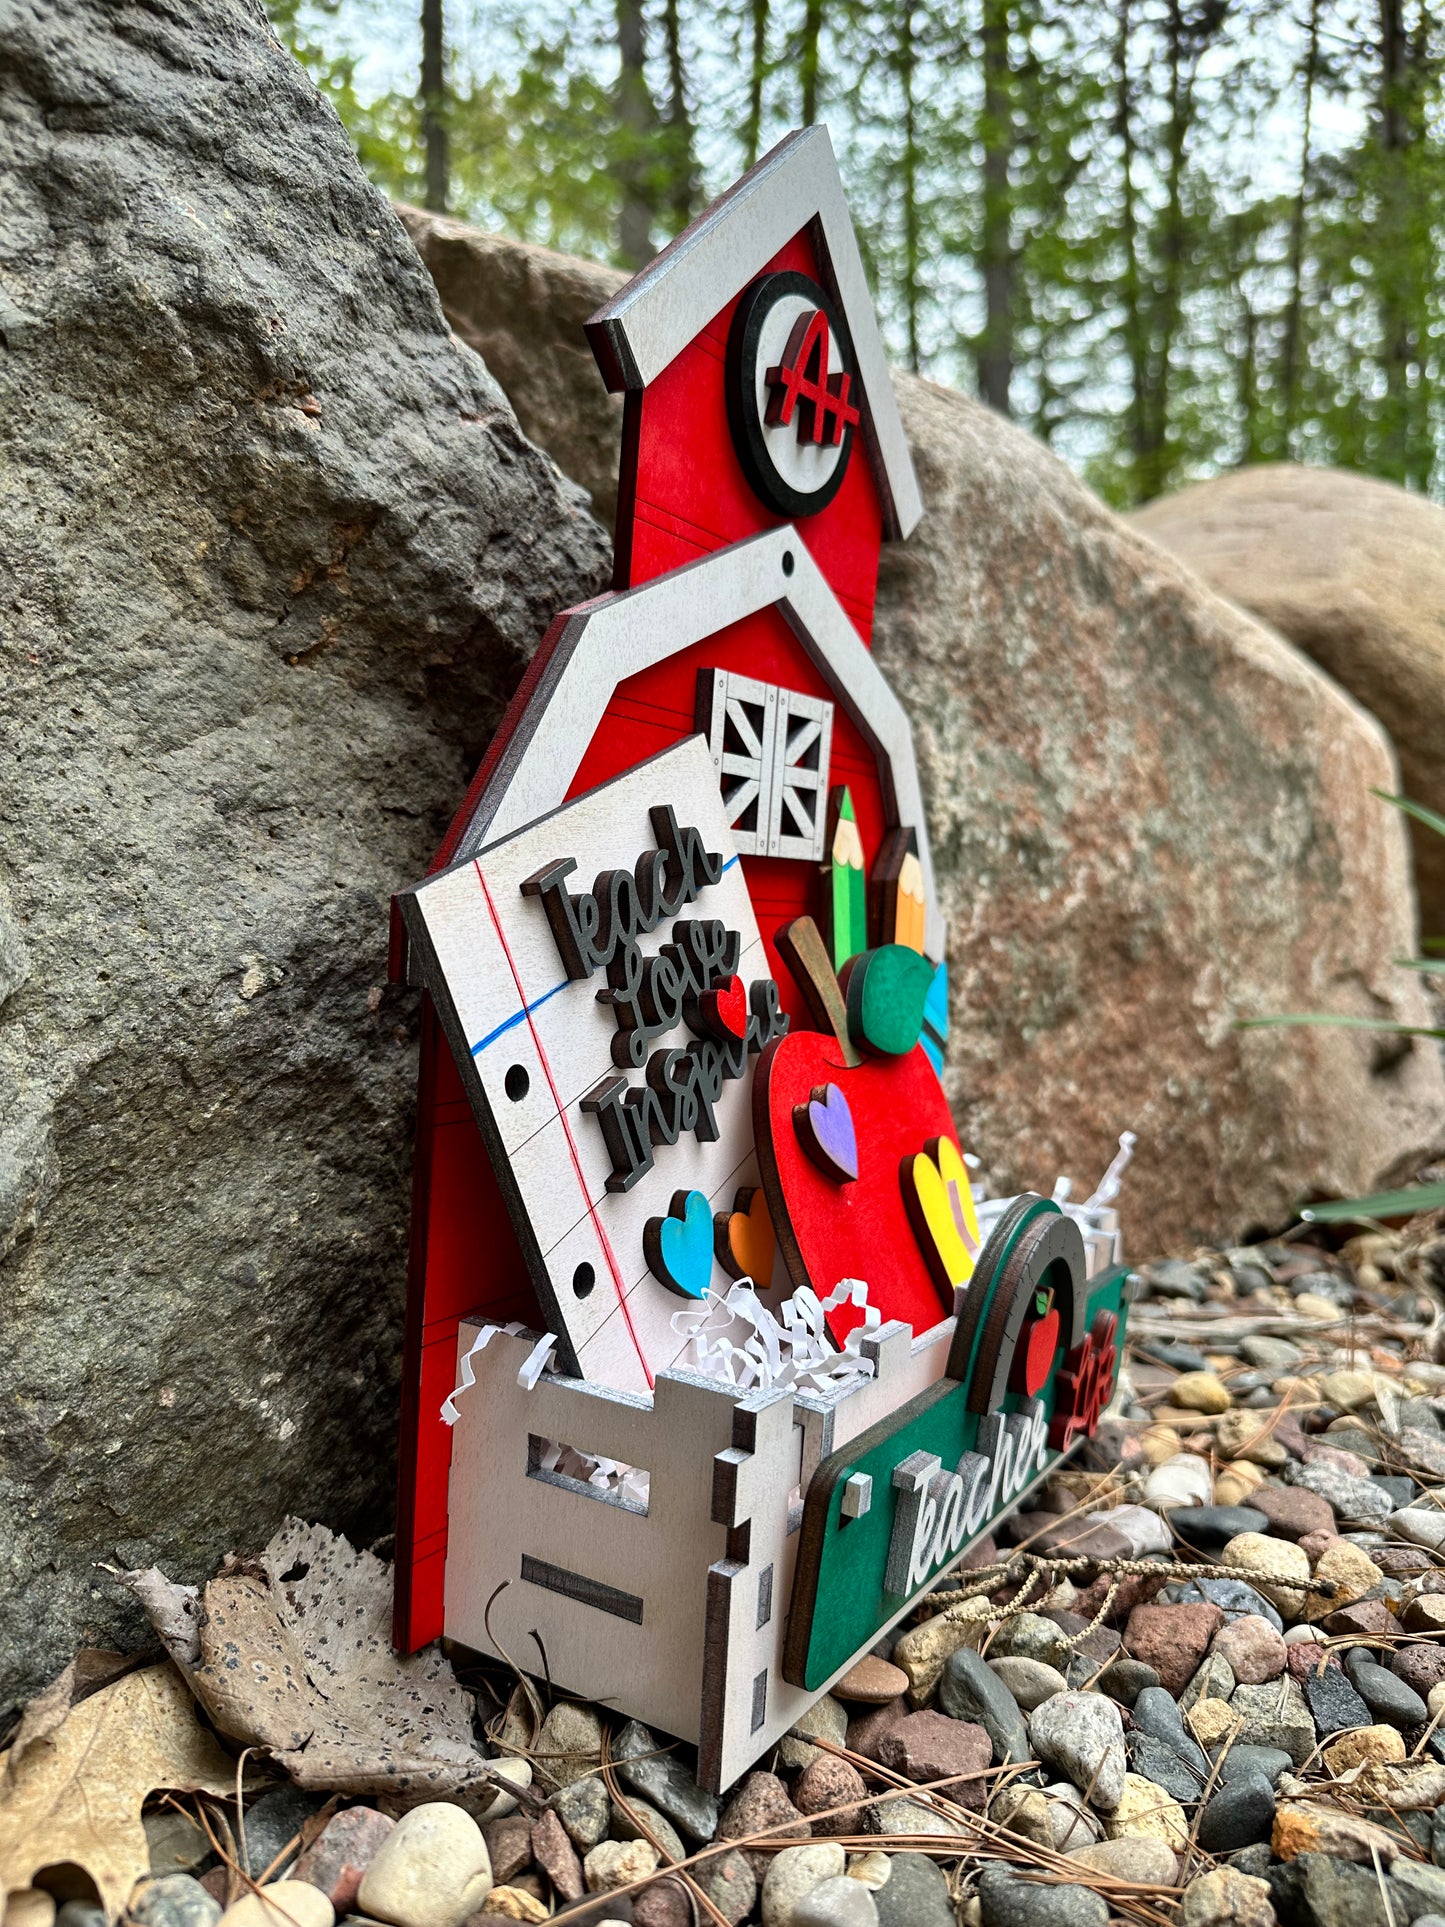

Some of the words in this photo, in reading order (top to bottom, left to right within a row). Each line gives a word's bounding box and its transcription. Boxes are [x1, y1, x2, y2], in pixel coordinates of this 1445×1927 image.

[525, 804, 724, 980] Teach
[581, 979, 791, 1193] Inspire
[596, 919, 741, 1069] Love
[890, 1399, 1049, 1598] Teacher
